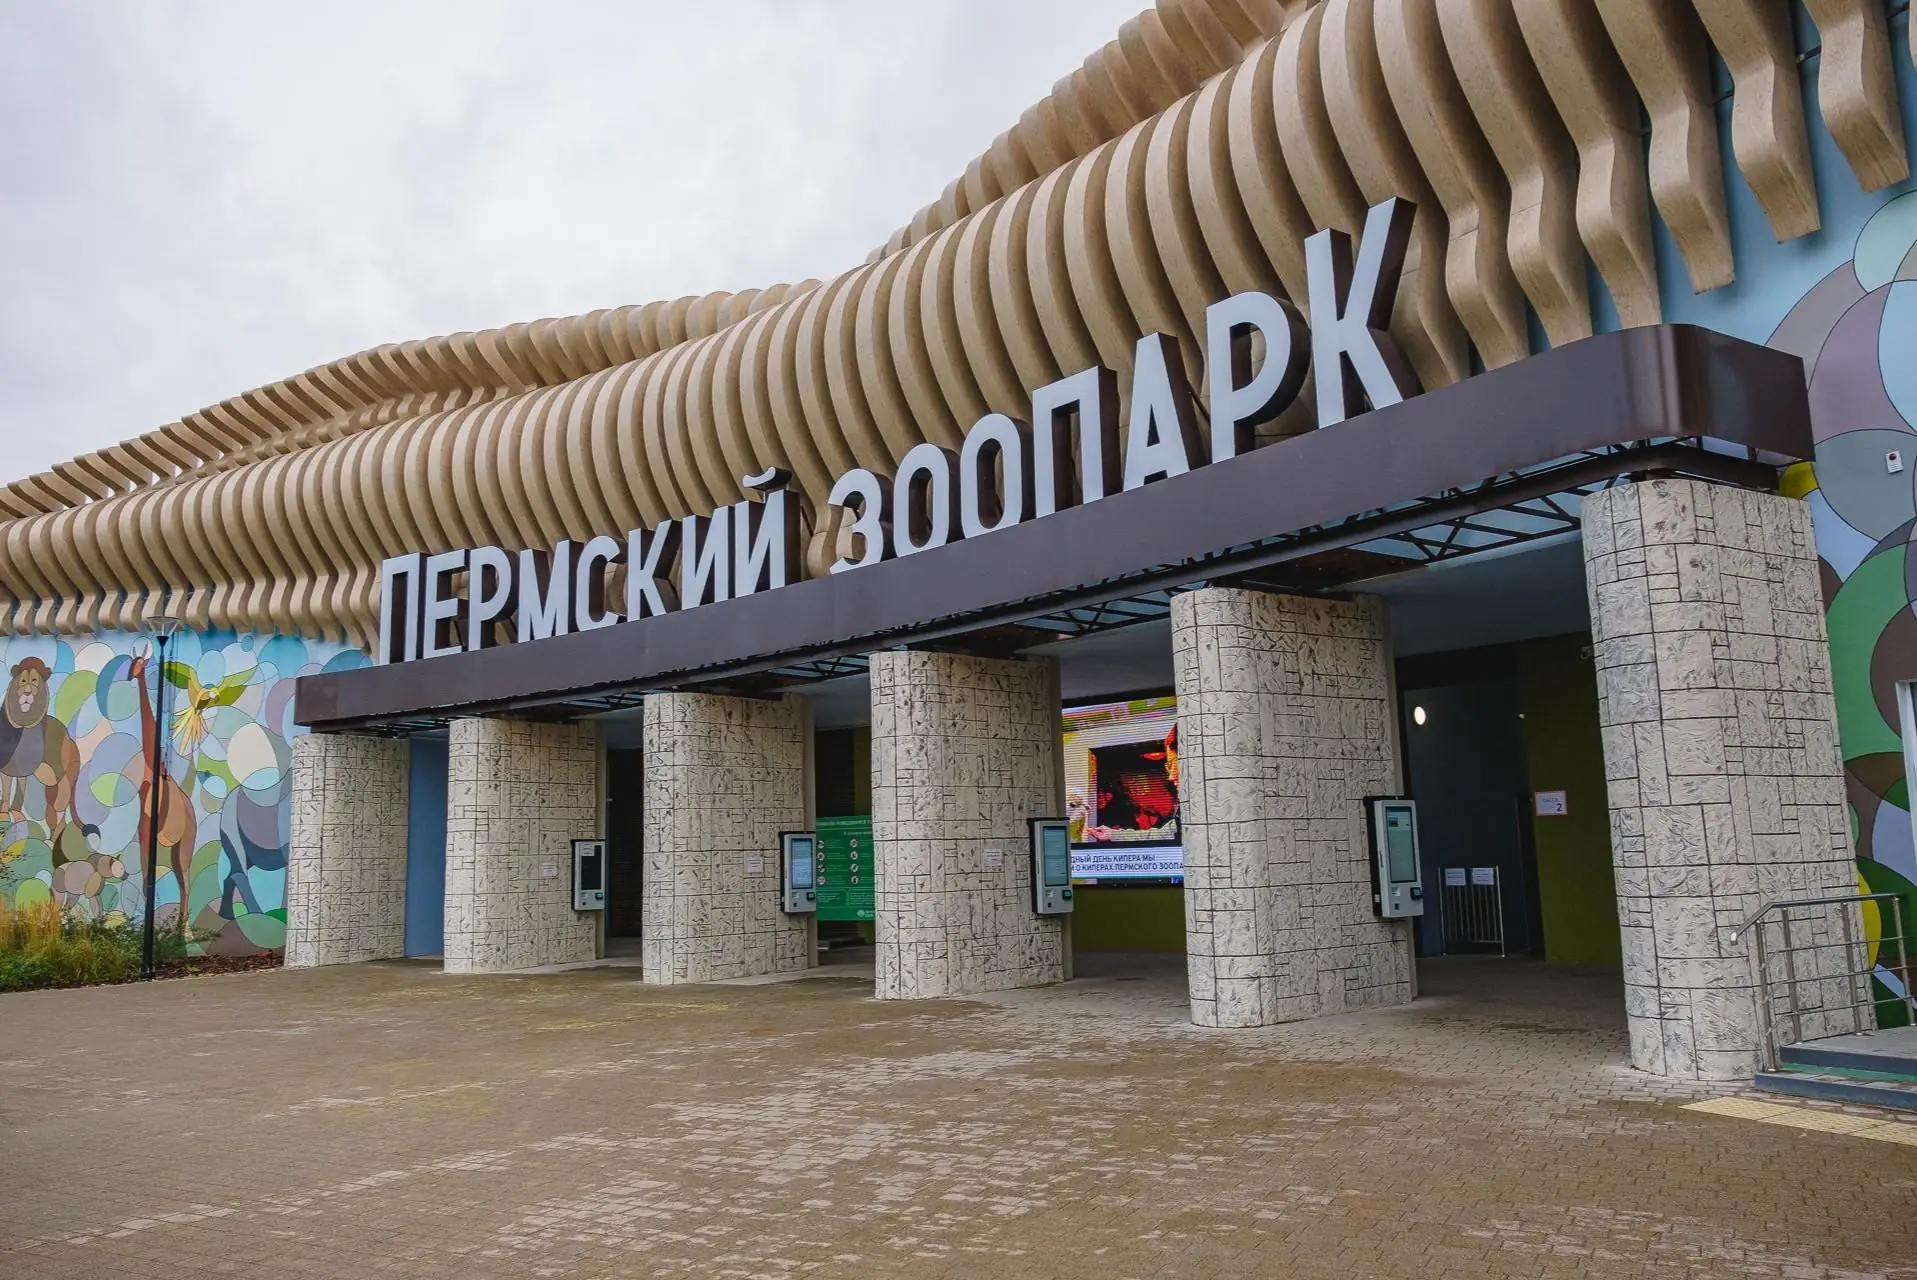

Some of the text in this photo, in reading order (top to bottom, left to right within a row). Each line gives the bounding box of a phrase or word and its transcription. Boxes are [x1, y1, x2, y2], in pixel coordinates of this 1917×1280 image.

[379, 196, 1408, 666] ПЕРМСКИЙ ЗООПАРК
[1556, 803, 1563, 812] 2
[1092, 855, 1112, 863] ДЕНЬ
[1113, 854, 1141, 862] КИПЕРА
[1082, 863, 1113, 871] КИПЕРАХ
[1115, 862, 1157, 870] ПЕРМСКОГО
